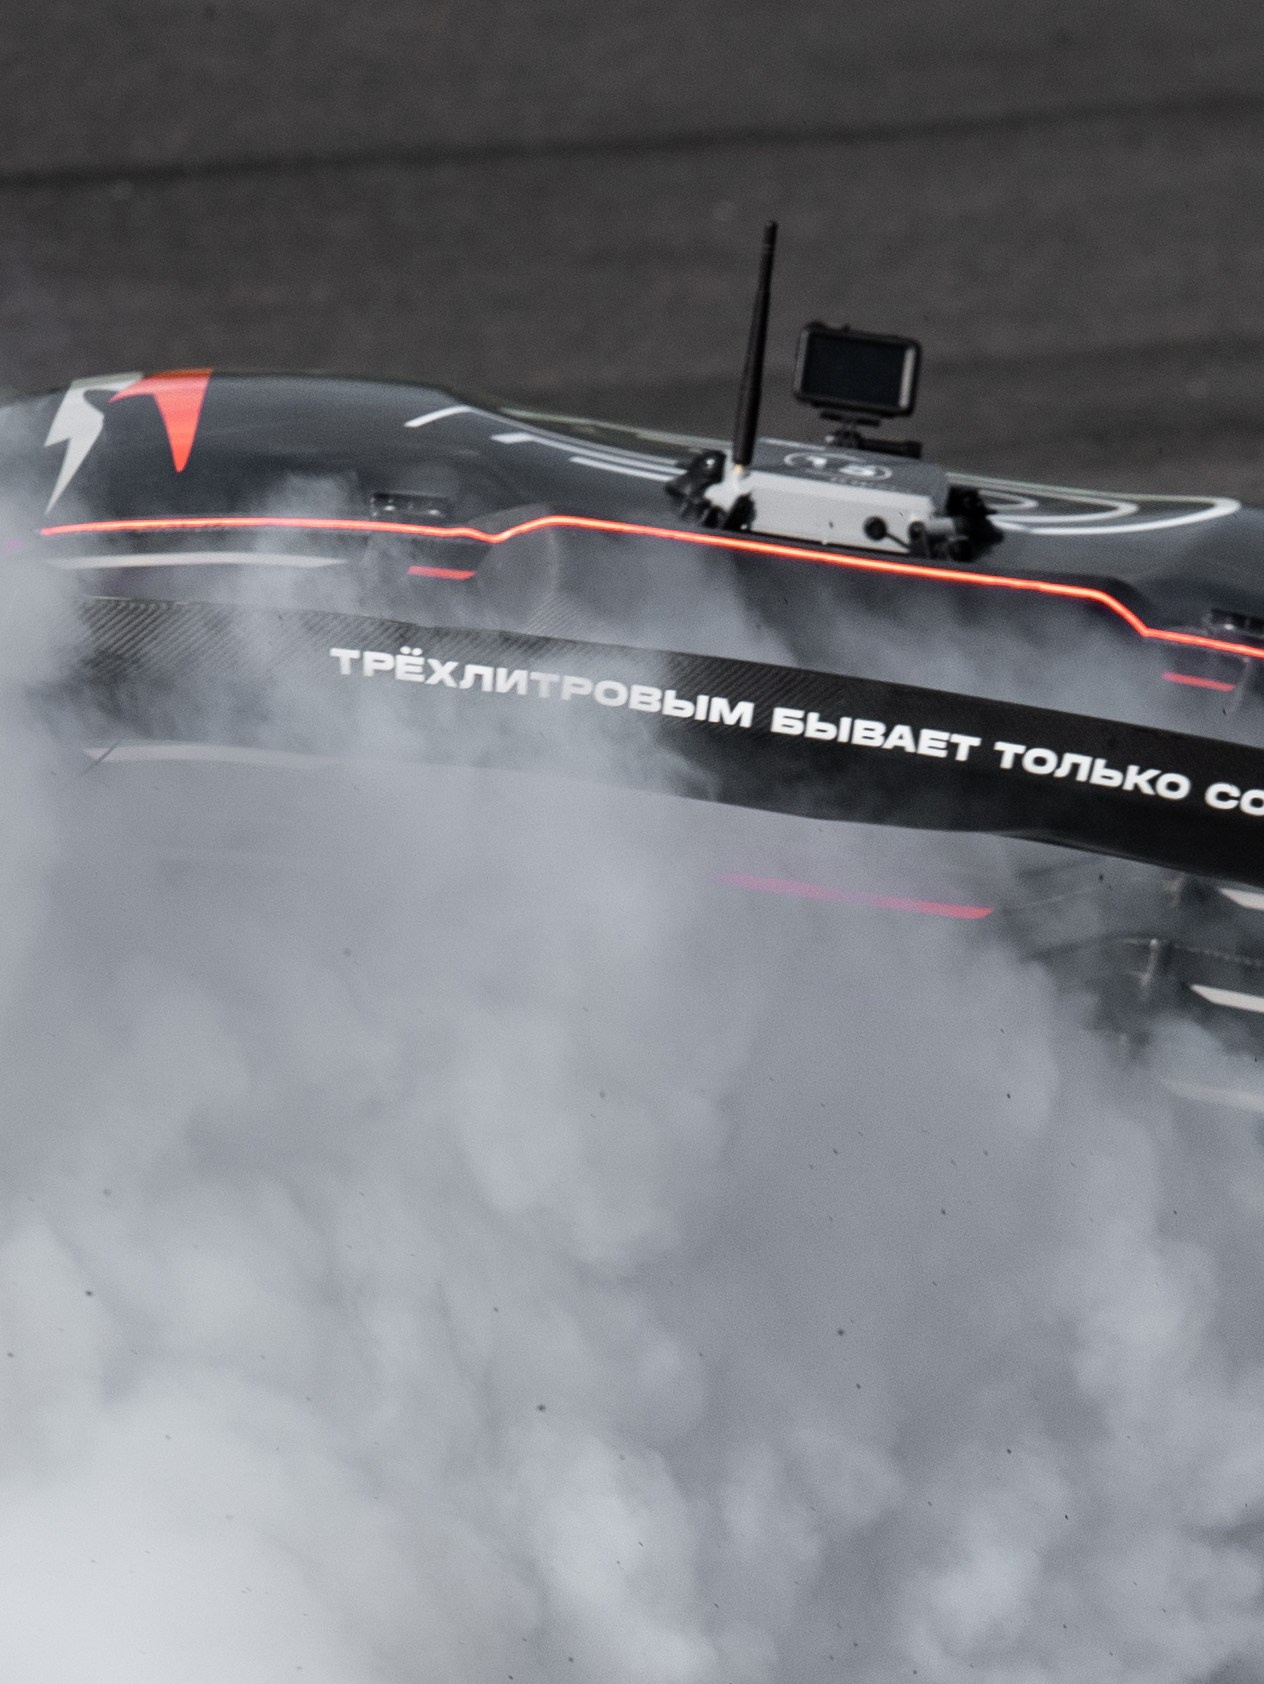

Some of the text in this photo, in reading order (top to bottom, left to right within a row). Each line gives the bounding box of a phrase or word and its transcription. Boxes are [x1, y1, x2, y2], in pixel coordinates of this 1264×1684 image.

[329, 646, 755, 728] ТРЁХЛИТРОВЫМ
[770, 707, 982, 762] БЫВАЕТ
[993, 741, 1192, 800] ТОЛЬКО
